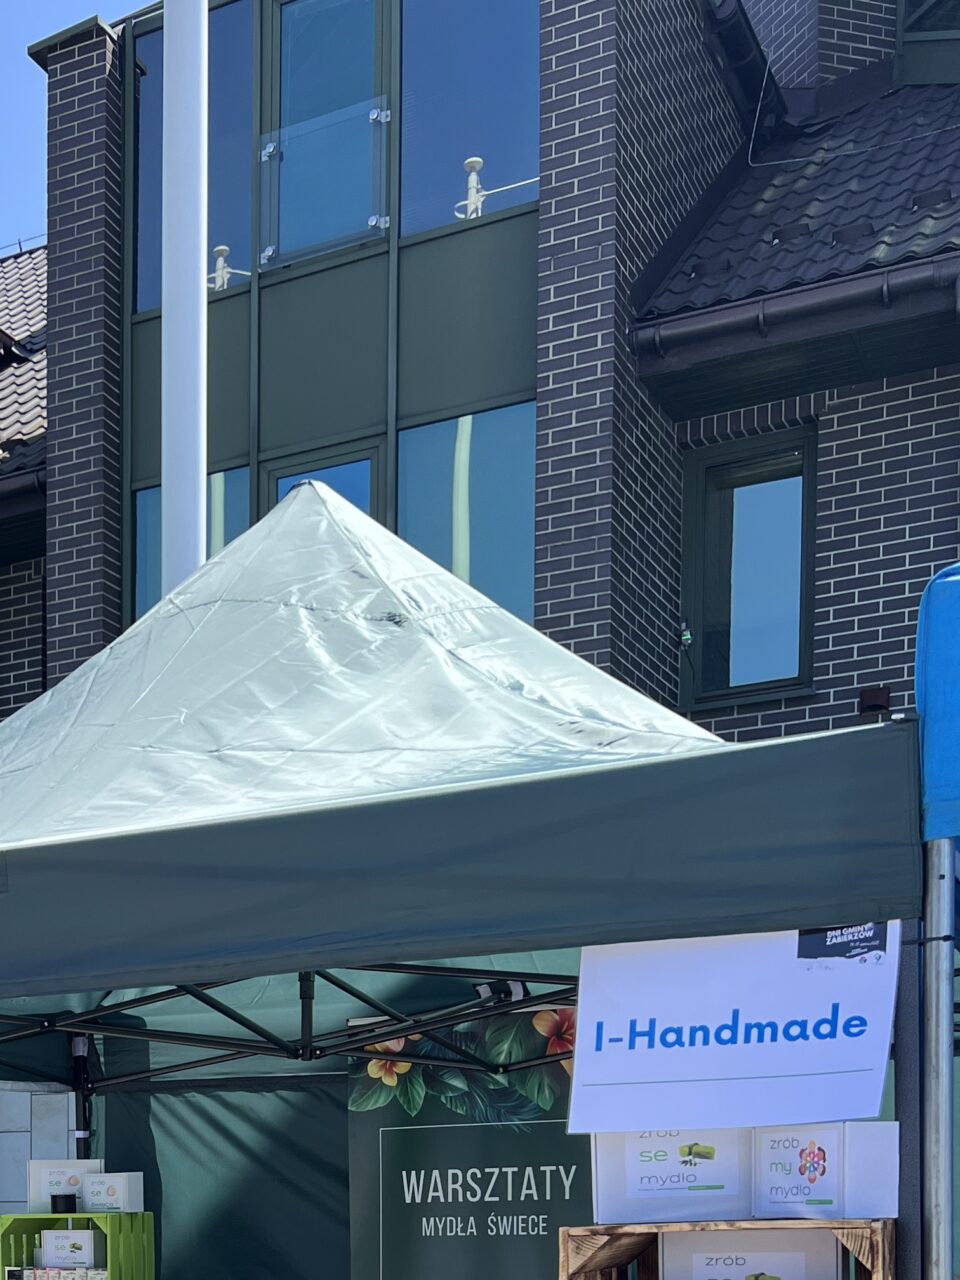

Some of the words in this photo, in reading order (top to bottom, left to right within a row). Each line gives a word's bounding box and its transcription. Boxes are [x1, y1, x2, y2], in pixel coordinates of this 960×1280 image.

[595, 1003, 868, 1051] I-Handmade
[640, 1150, 668, 1162] se
[770, 1161, 792, 1175] my
[402, 1165, 577, 1203] WARSZTATY
[422, 1217, 477, 1236] MYDŁA
[487, 1212, 548, 1236] ŚWIECE
[705, 1255, 746, 1266] zrób
